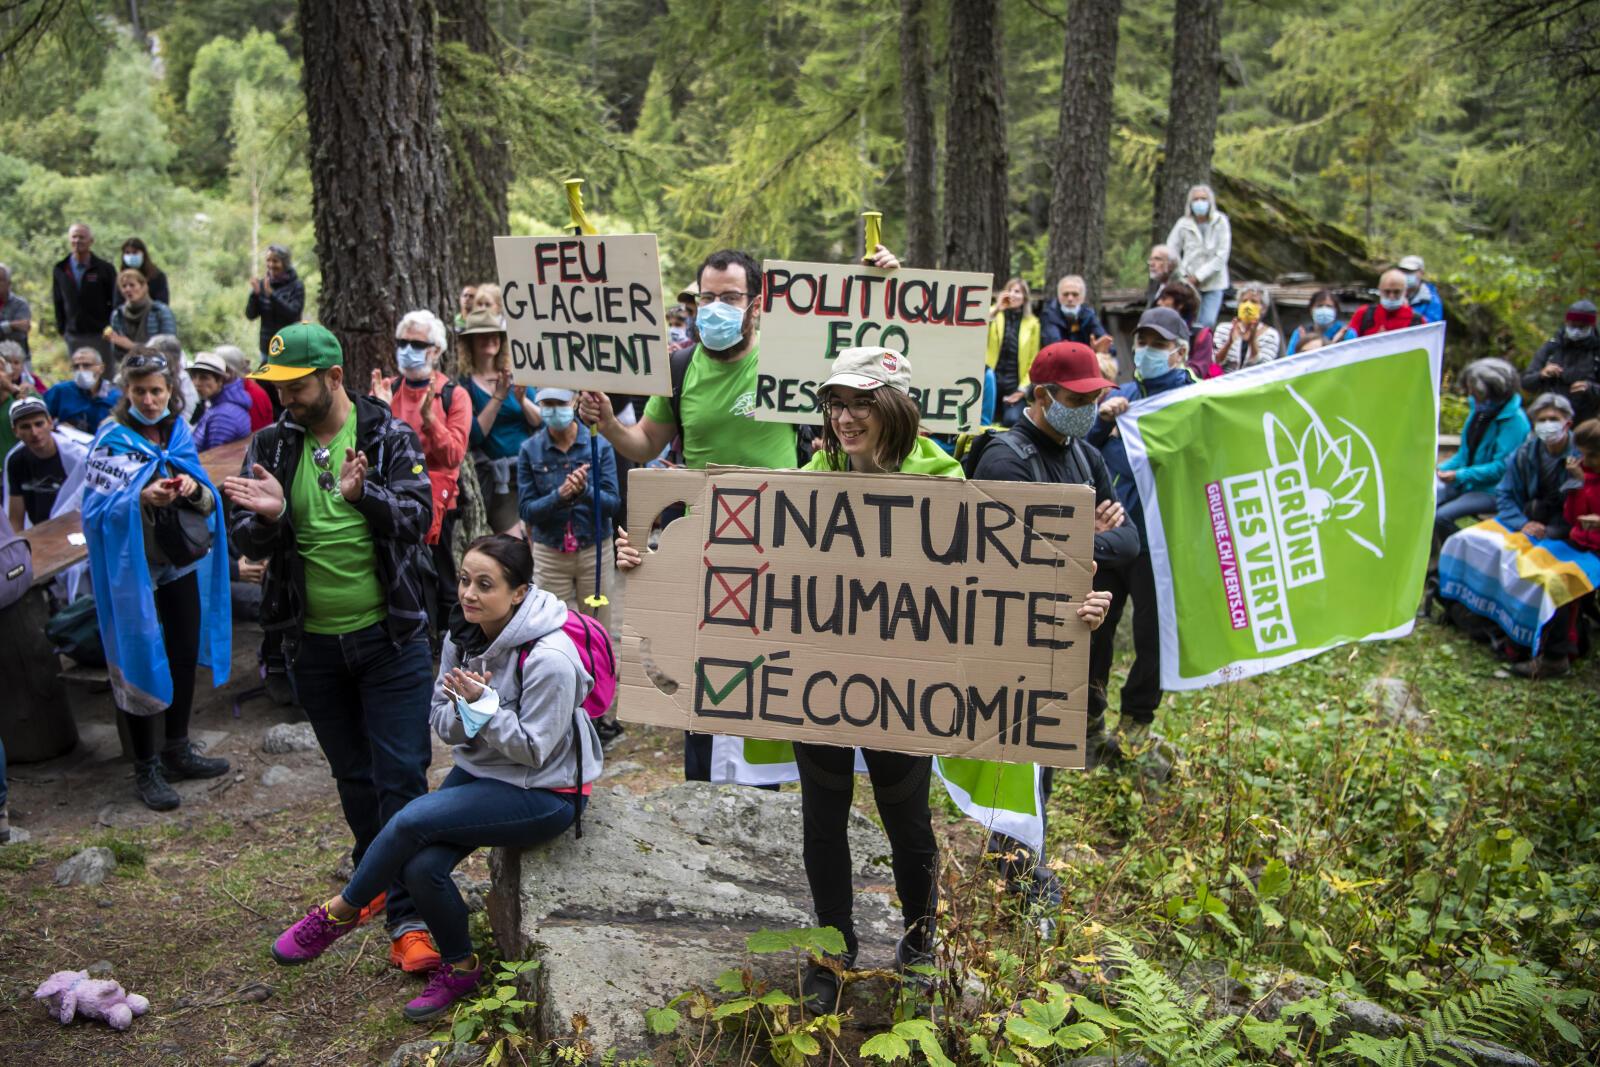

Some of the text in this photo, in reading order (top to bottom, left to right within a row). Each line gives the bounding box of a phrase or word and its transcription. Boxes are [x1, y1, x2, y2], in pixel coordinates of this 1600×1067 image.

[534, 240, 609, 285] FEU
[503, 281, 657, 326] GLACIER
[762, 269, 989, 326] POLITIQUE
[825, 321, 910, 359] ECO
[772, 489, 1075, 569] NATURE
[1274, 468, 1317, 582] GRÜNE
[1230, 478, 1288, 644] LES VERTS
